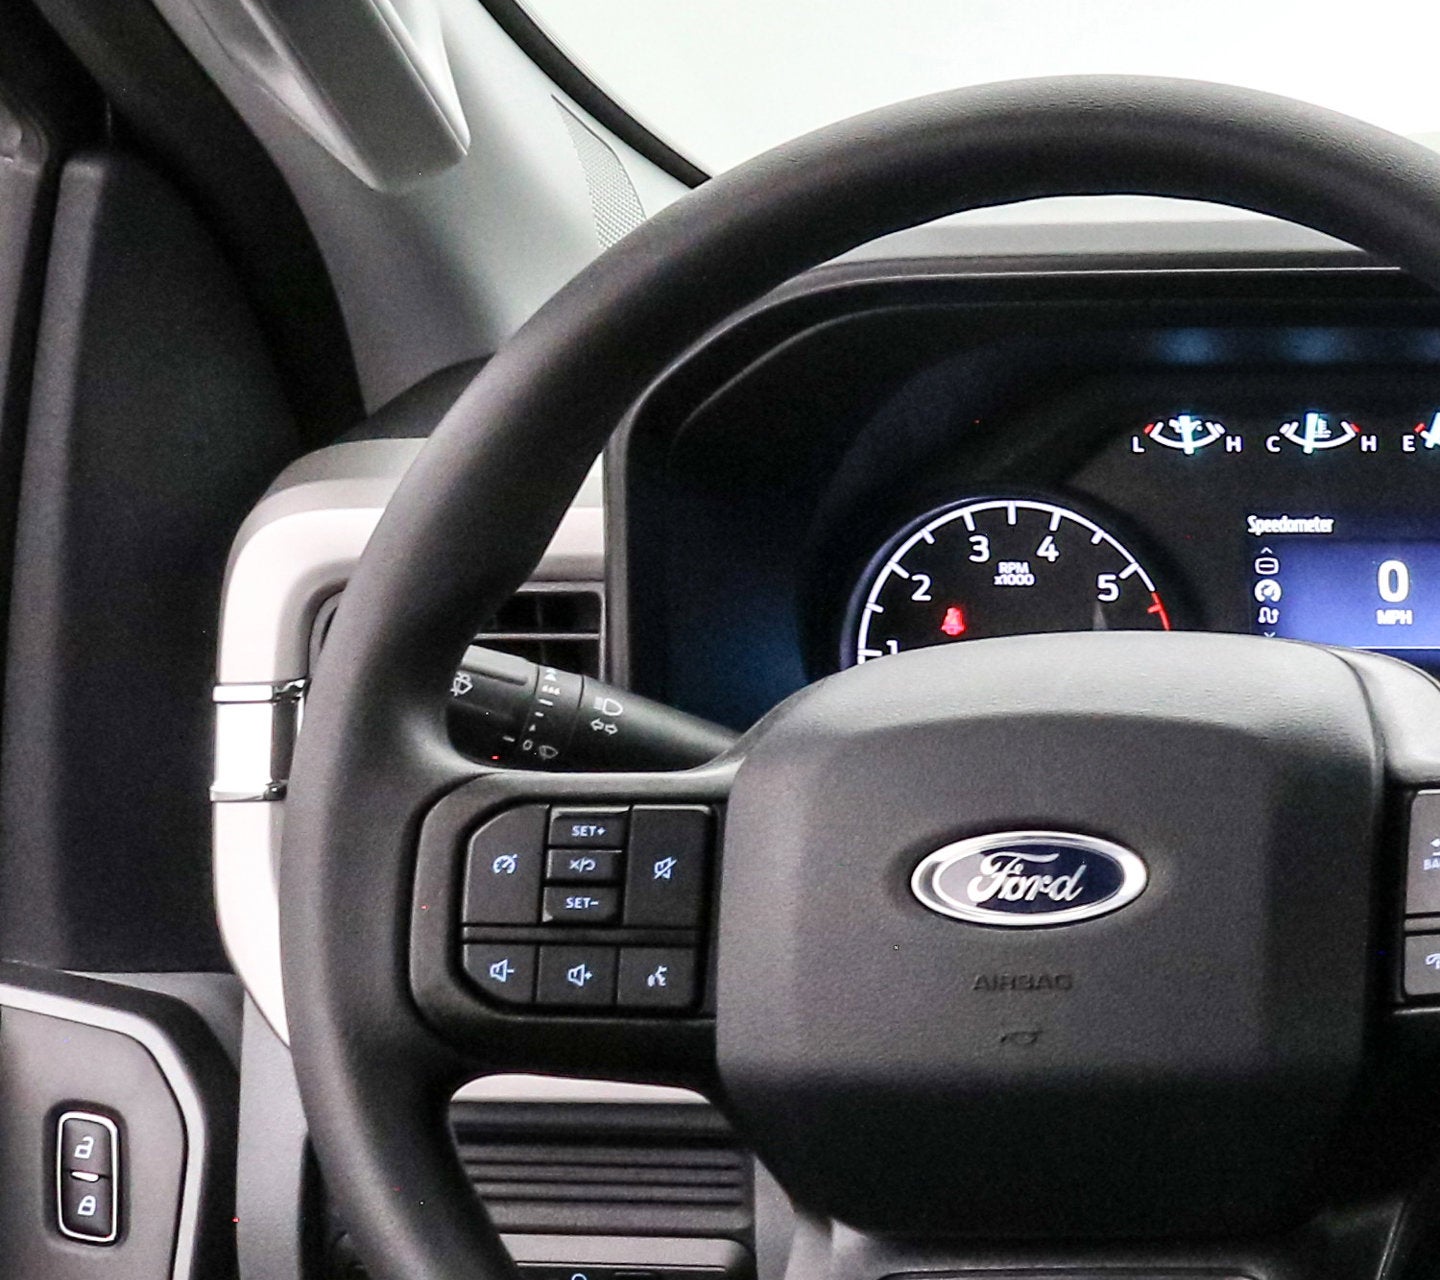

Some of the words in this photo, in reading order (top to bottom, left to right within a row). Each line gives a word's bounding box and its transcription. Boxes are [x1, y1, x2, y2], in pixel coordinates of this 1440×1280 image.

[1132, 436, 1145, 453] L
[1226, 436, 1241, 452] H
[1266, 436, 1281, 452] C
[1361, 436, 1376, 452] H
[1403, 436, 1415, 452] E
[1247, 515, 1335, 535] Speedometer
[969, 535, 990, 562] 3
[1036, 536, 1059, 562] 4
[997, 561, 1030, 574] RPM
[911, 574, 932, 602] 2
[994, 573, 1035, 587] x1000
[1097, 574, 1120, 602] 5
[1376, 560, 1410, 604] 0
[1376, 609, 1413, 625] MPH
[571, 825, 606, 838] SET+
[966, 851, 1088, 903] Ford
[973, 972, 1073, 992] AIRBAG
